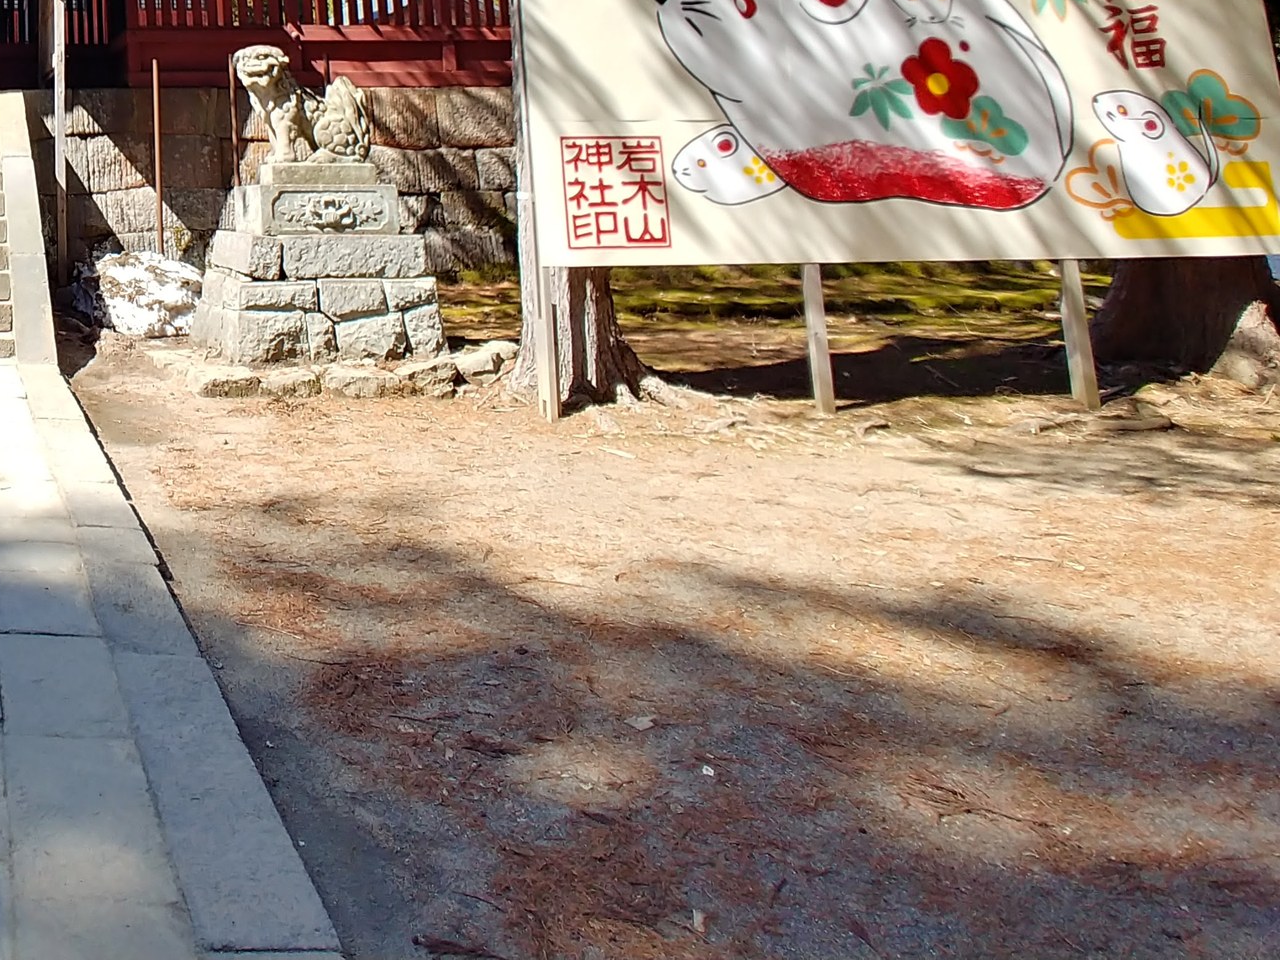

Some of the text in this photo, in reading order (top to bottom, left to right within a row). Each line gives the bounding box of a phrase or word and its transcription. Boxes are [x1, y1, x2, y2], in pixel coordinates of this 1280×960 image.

[565, 140, 619, 245] 神社印
[616, 140, 667, 243] 岩木山
